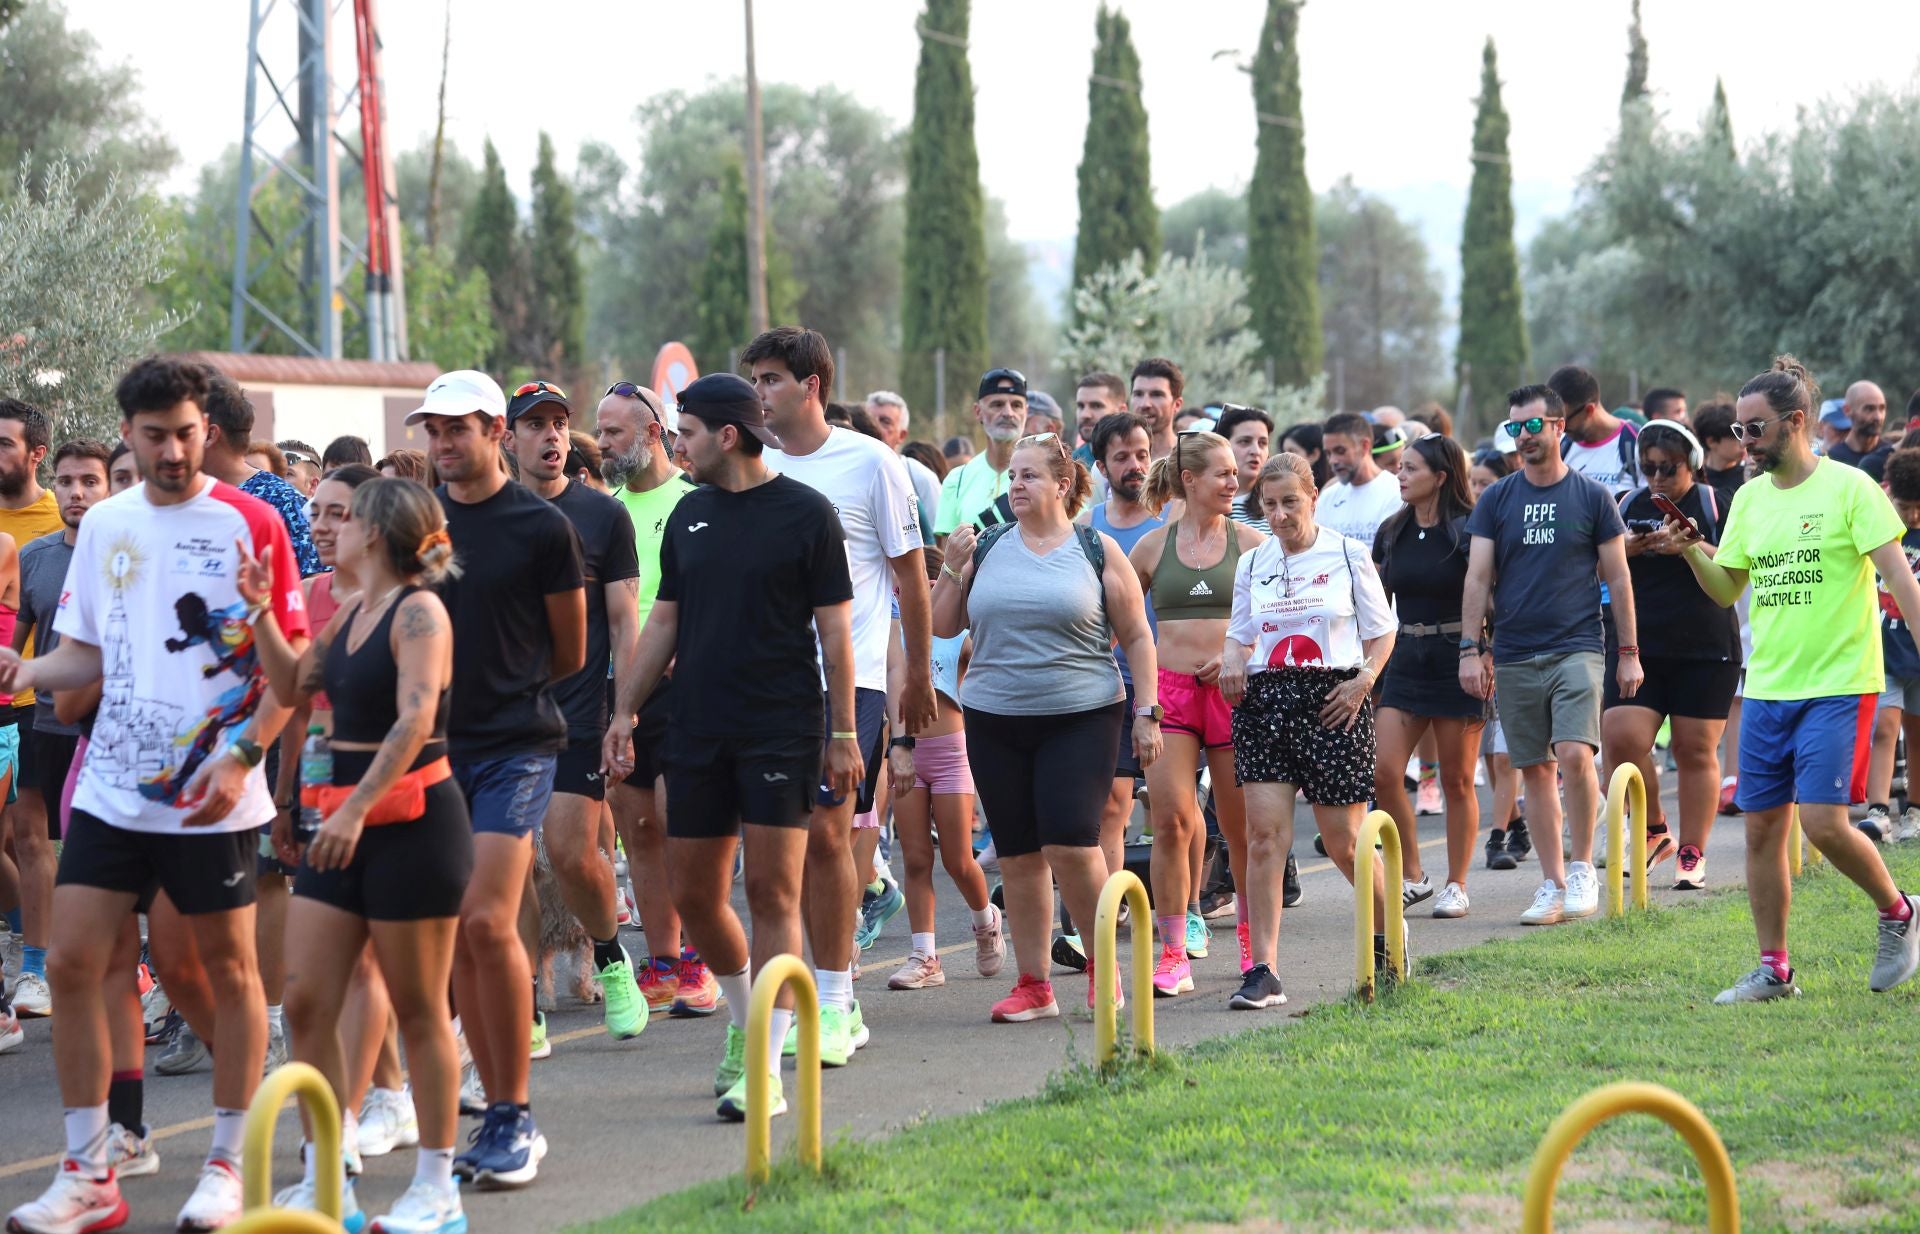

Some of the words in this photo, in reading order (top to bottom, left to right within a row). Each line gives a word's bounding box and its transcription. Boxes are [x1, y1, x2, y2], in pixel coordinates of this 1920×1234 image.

[1523, 503, 1557, 522] PEPE
[1523, 528, 1555, 545] JEANS
[1757, 551, 1795, 568] MÓJATE
[1797, 548, 1821, 563] POR
[1190, 588, 1213, 596] adidas
[1756, 591, 1801, 607] MÚLTIPLE
[1804, 591, 1812, 605] !!
[1266, 600, 1292, 609] CARRERA
[1293, 597, 1324, 606] NOCTURNA
